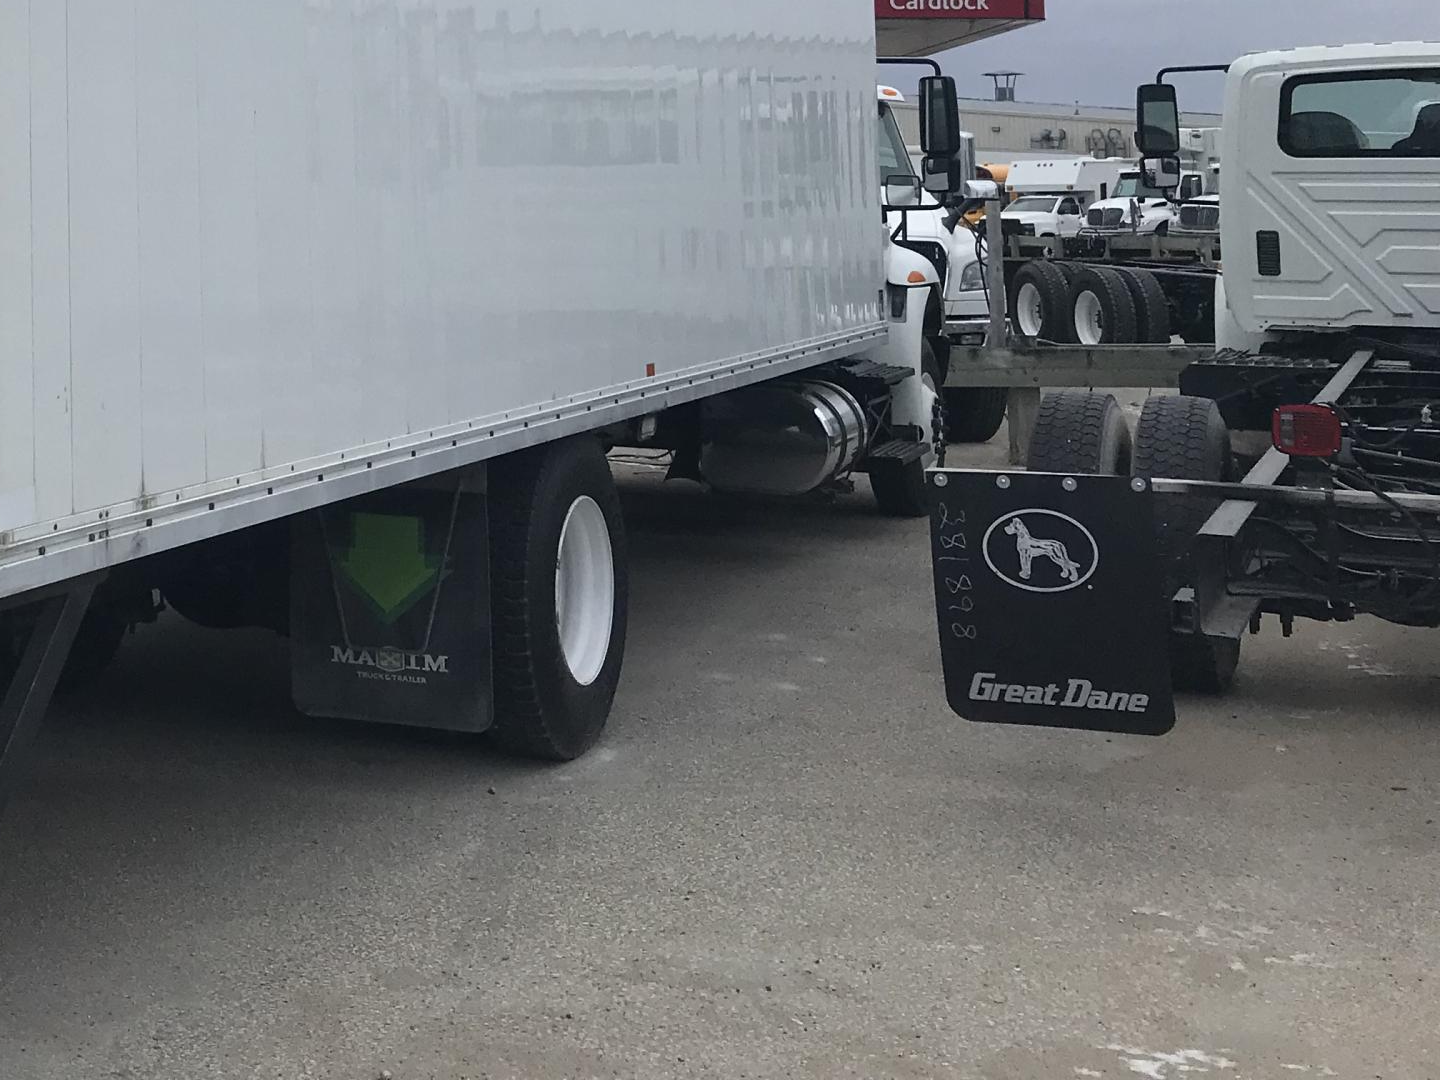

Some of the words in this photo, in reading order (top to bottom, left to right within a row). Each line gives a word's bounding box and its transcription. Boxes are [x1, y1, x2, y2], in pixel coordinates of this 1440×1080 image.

[330, 645, 449, 672] MAXIM
[969, 672, 1060, 706] Great
[1060, 678, 1149, 712] Dane
